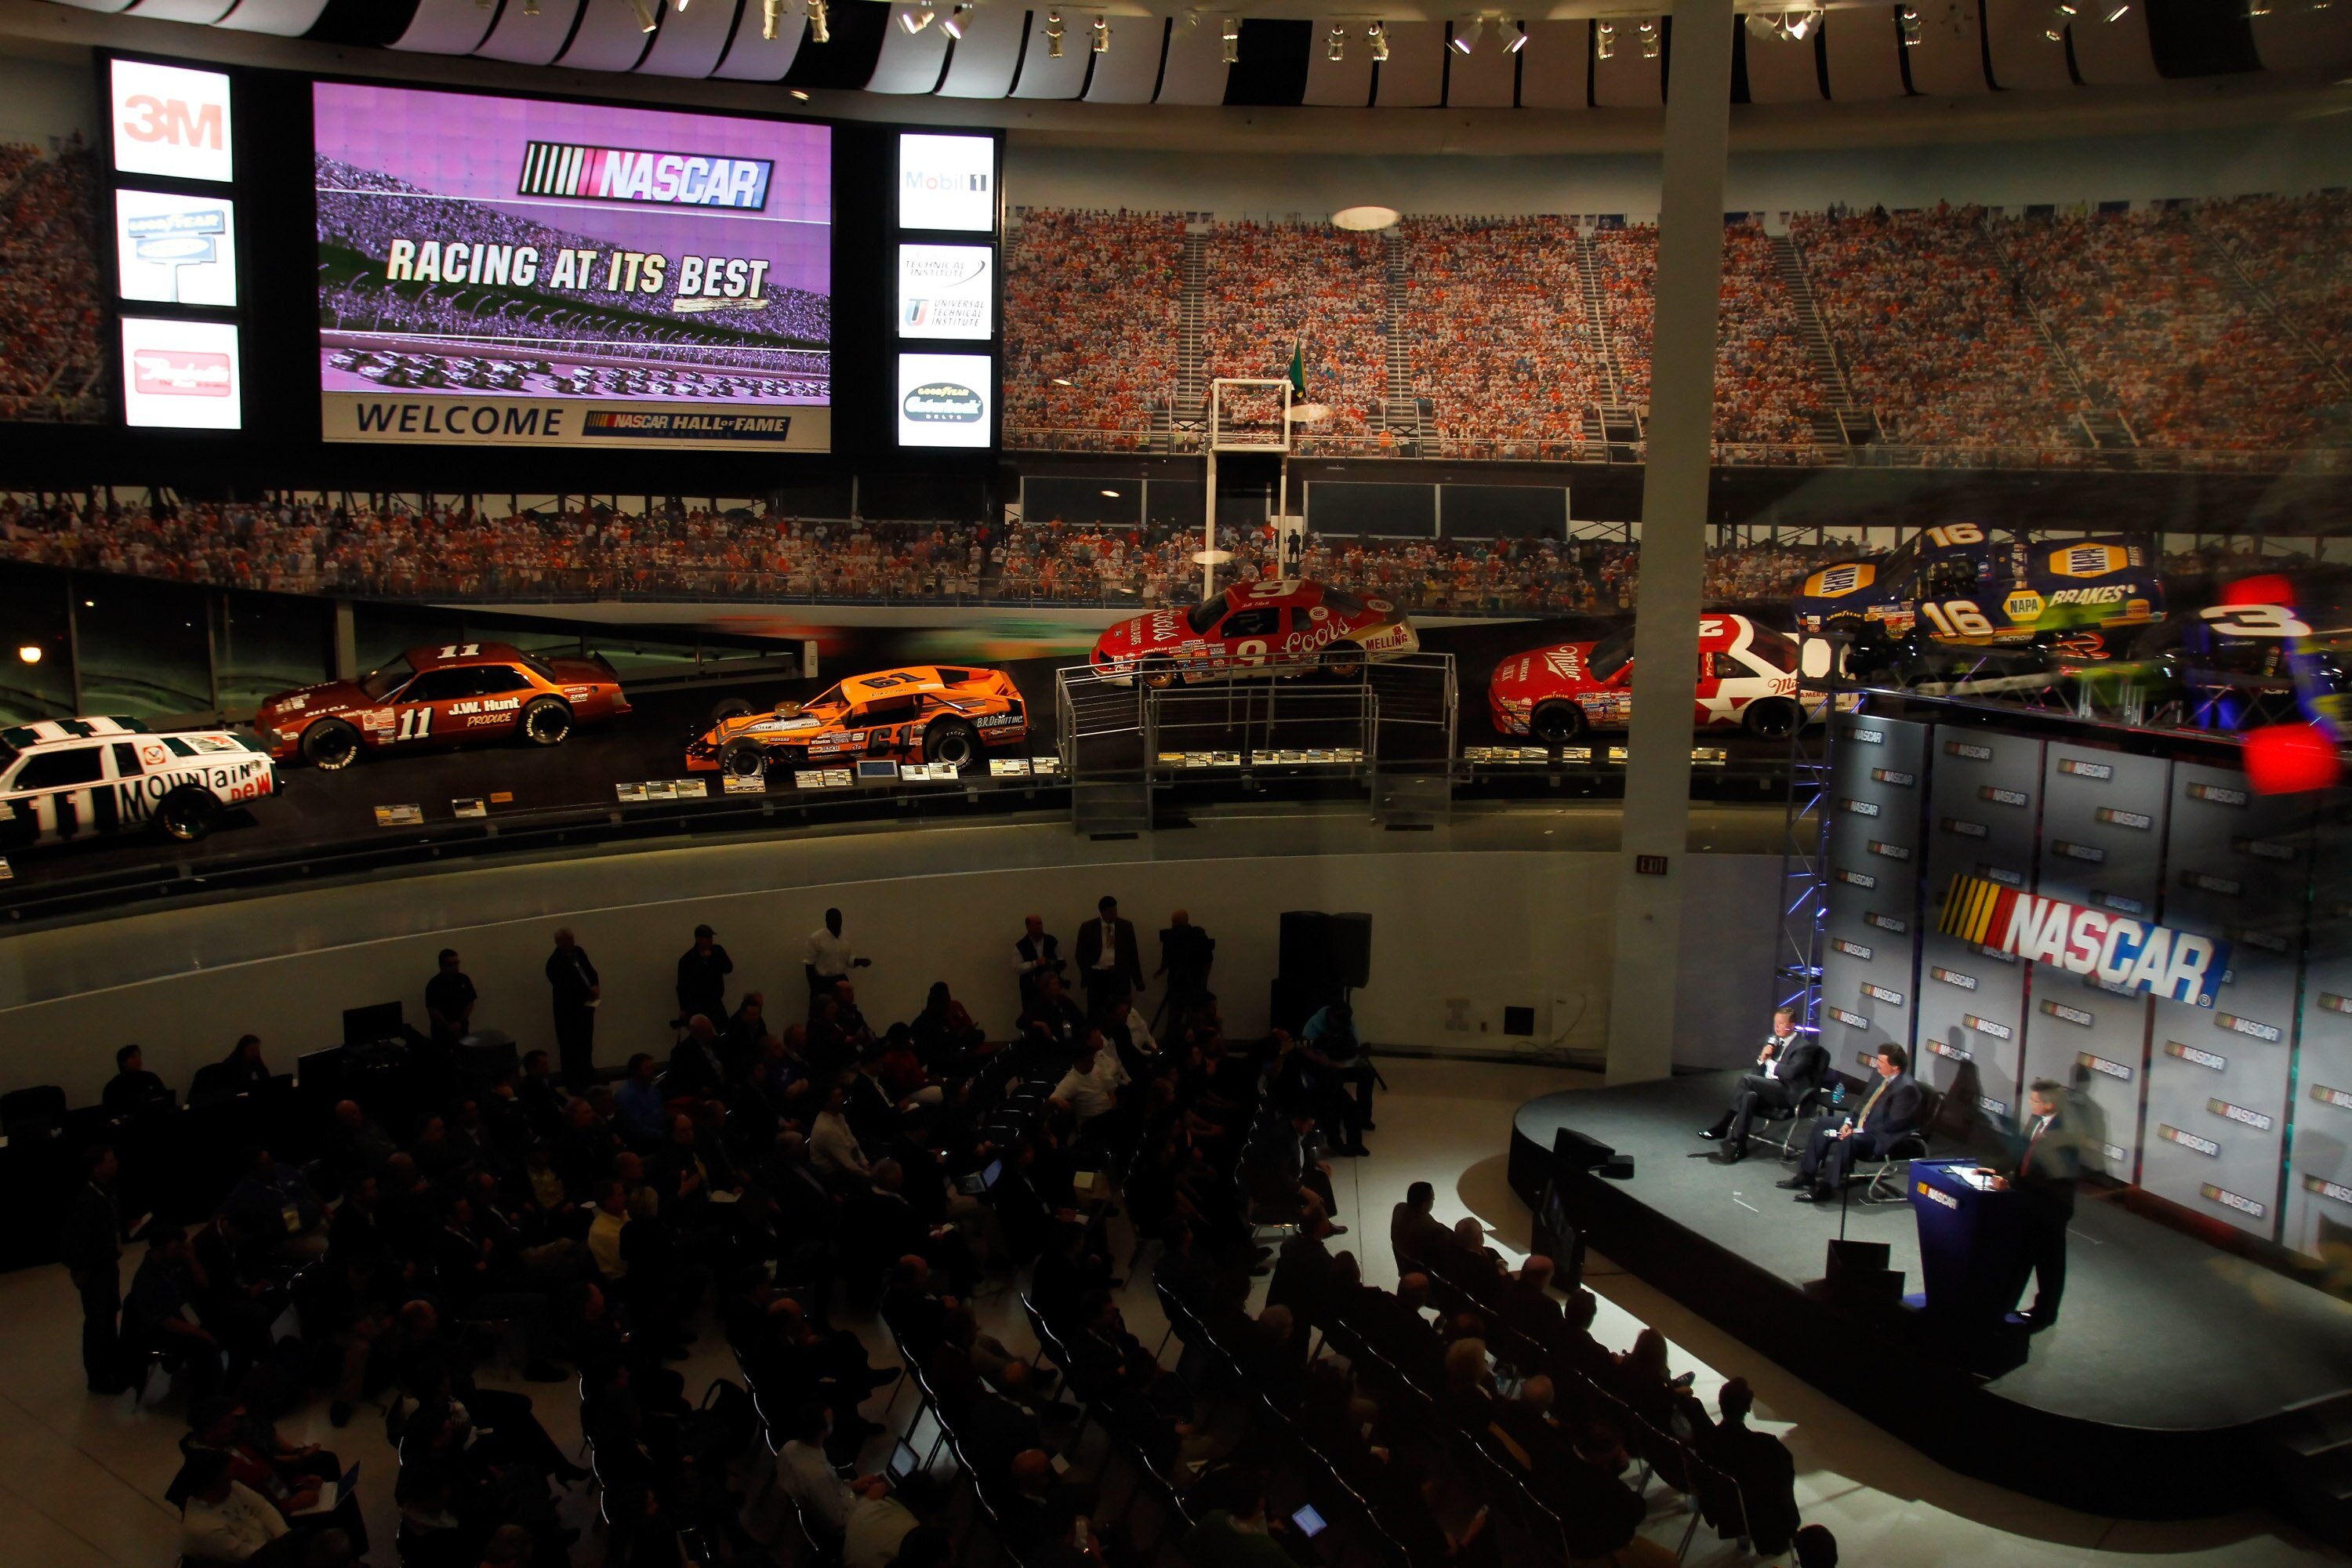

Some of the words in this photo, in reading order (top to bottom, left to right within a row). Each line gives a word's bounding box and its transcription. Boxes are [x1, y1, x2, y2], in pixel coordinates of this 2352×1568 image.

[124, 95, 223, 151] 3M
[599, 151, 760, 209] NASCAR
[906, 171, 964, 191] Mobil
[387, 238, 539, 287] RACING
[549, 249, 598, 290] AT
[607, 252, 666, 295] ITS
[677, 256, 770, 299] BEST
[906, 260, 964, 270] TECHNICAL
[910, 269, 964, 278] INSTITUTE
[933, 308, 982, 318] TECHNICAL
[935, 299, 984, 309] UNIVERSAL
[931, 318, 979, 327] INSTITUTE
[357, 403, 564, 436] WELCOME
[614, 413, 669, 429] NASCAR
[673, 416, 724, 430] HALL
[734, 418, 786, 432] FAME
[1926, 522, 1985, 548] 16
[1249, 580, 1301, 598] 9
[1822, 566, 1857, 593] NAPA
[2010, 598, 2039, 613] NAPA
[2048, 585, 2126, 607] BRAKES
[1152, 610, 1182, 642] Coors
[1922, 600, 1994, 637] 16
[2199, 604, 2313, 637] 3
[1281, 616, 1350, 659] Coors
[1366, 633, 1408, 651] MELLING
[437, 644, 480, 659] 11
[1236, 640, 1268, 667] 9
[1546, 645, 1581, 681] Miller
[859, 673, 926, 689] 61
[448, 702, 481, 716] J.W.
[484, 696, 521, 712] Hunt
[397, 707, 432, 741] 11
[466, 713, 512, 727] PRODUCE
[21, 716, 138, 745] 11
[1853, 728, 1882, 744] NASCAR
[867, 724, 912, 757] 61
[1958, 744, 1991, 760] NASCAR
[1883, 771, 1913, 786] NASCAR
[2074, 761, 2111, 779] NASCAR
[1993, 788, 2026, 805] NASCAR
[2204, 786, 2247, 805] NASCAR
[28, 786, 100, 845] 11
[1850, 800, 1878, 815] NASCAR
[1954, 821, 1987, 837] NASCAR
[2112, 811, 2151, 829] NASCAR
[1881, 843, 1909, 859] NASCAR
[1640, 856, 1664, 873] EXIT
[1846, 871, 1874, 888] NASCAR
[1988, 868, 2021, 884] NASCAR
[1876, 916, 1905, 932] NASCAR
[1844, 942, 1871, 959] NASCAR
[2002, 893, 2215, 1005] NASCAR
[1944, 971, 1976, 990] NASCAR
[1873, 988, 1901, 1005] NASCAR
[1841, 1011, 1867, 1029] NASCAR
[2057, 1004, 2091, 1026] NASCAR
[1976, 1019, 2010, 1040] NASCAR
[2234, 1018, 2278, 1042] NASCAR
[2095, 1058, 2130, 1080] NASCAR
[2184, 1048, 2225, 1071] NASCAR
[1981, 1096, 2005, 1115] SCAR
[2226, 1105, 2271, 1131] NASCAR
[2176, 1131, 2217, 1156] NASCAR
[1928, 1187, 1958, 1210] NASCAR
[2220, 1190, 2263, 1217] NASCAR
